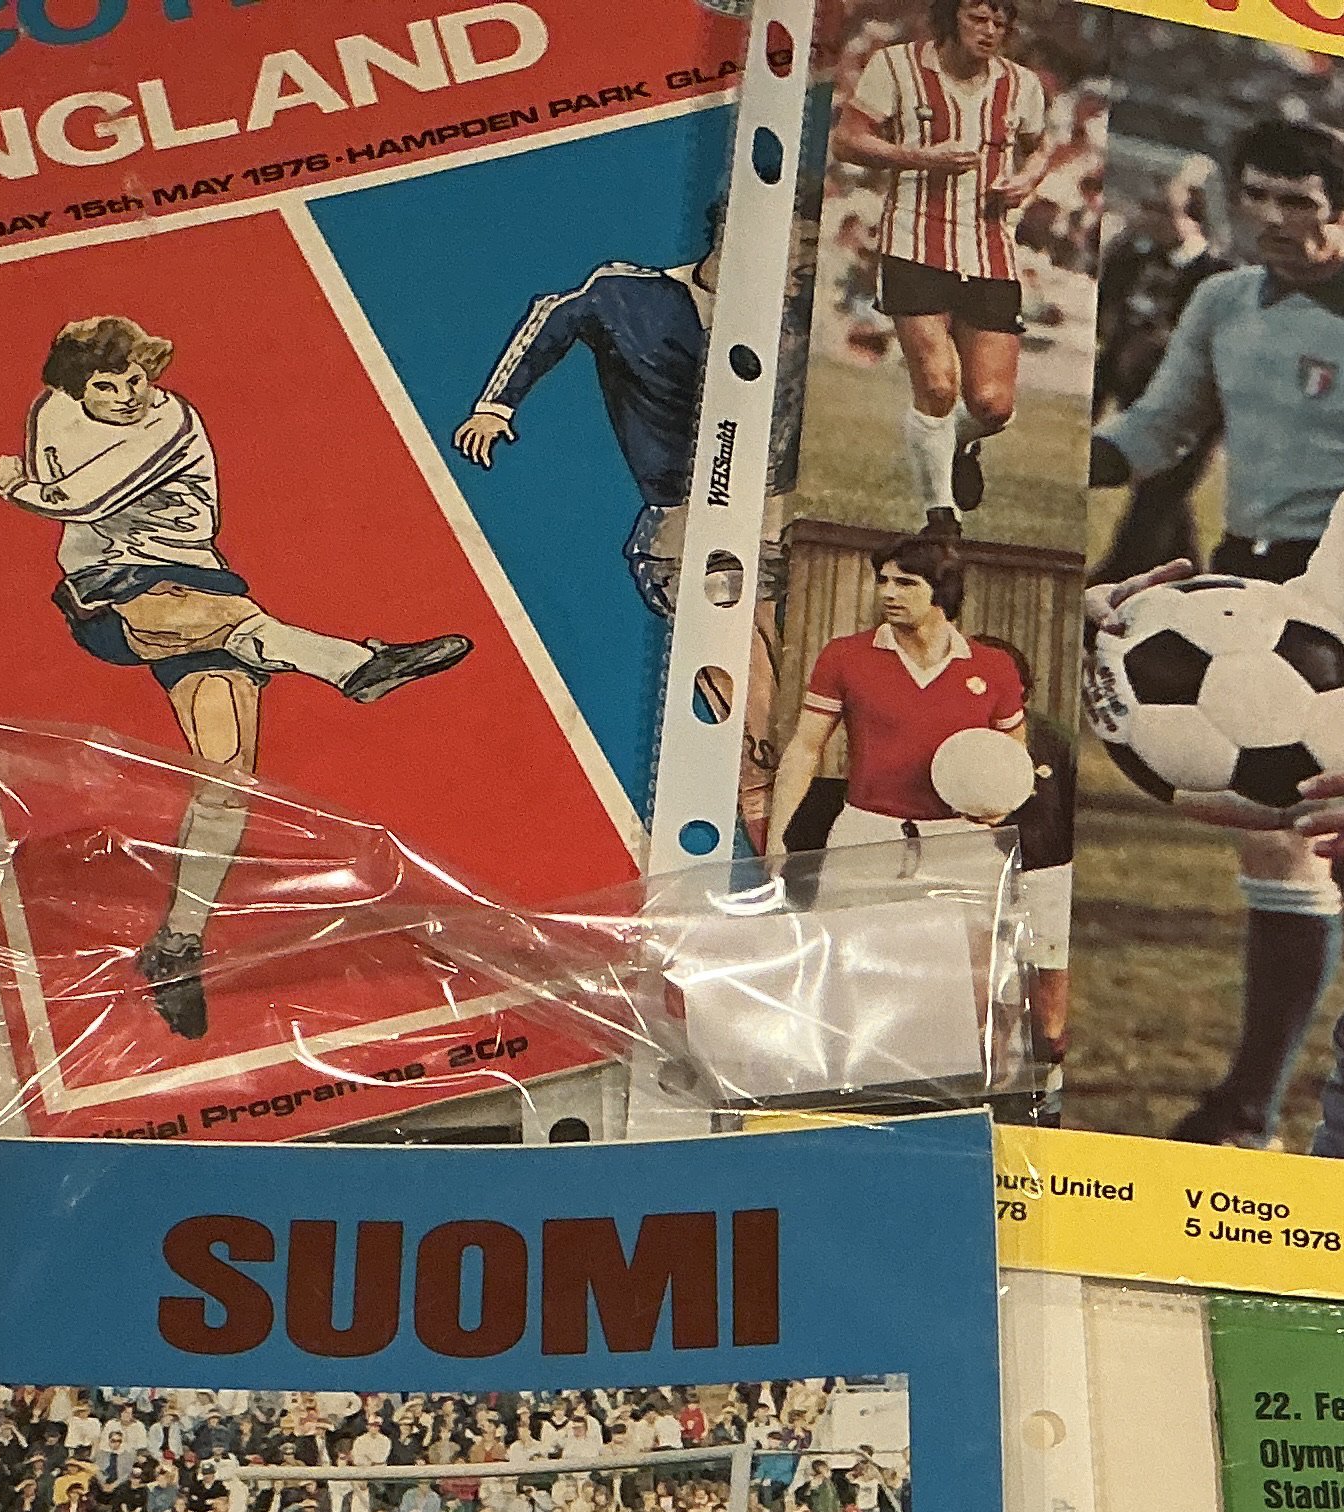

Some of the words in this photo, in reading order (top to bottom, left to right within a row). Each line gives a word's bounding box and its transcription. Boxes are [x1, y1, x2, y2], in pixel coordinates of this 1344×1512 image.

[63, 195, 145, 220] 15th
[152, 171, 235, 207] MAY
[242, 153, 331, 187] 1976
[346, 106, 539, 163] HAMPDEN
[550, 81, 651, 118] PARK
[708, 418, 738, 507] WHSmith
[447, 1035, 529, 1068] 20p
[996, 1175, 1043, 1194] urs
[1050, 1175, 1134, 1201] United
[1185, 1189, 1202, 1209] V
[1210, 1192, 1290, 1221] Otago
[1184, 1218, 1201, 1237] 5
[1209, 1221, 1273, 1244] June
[1280, 1228, 1342, 1251] 1978
[157, 1207, 780, 1357] SUOMI
[1256, 1393, 1303, 1422] 22.
